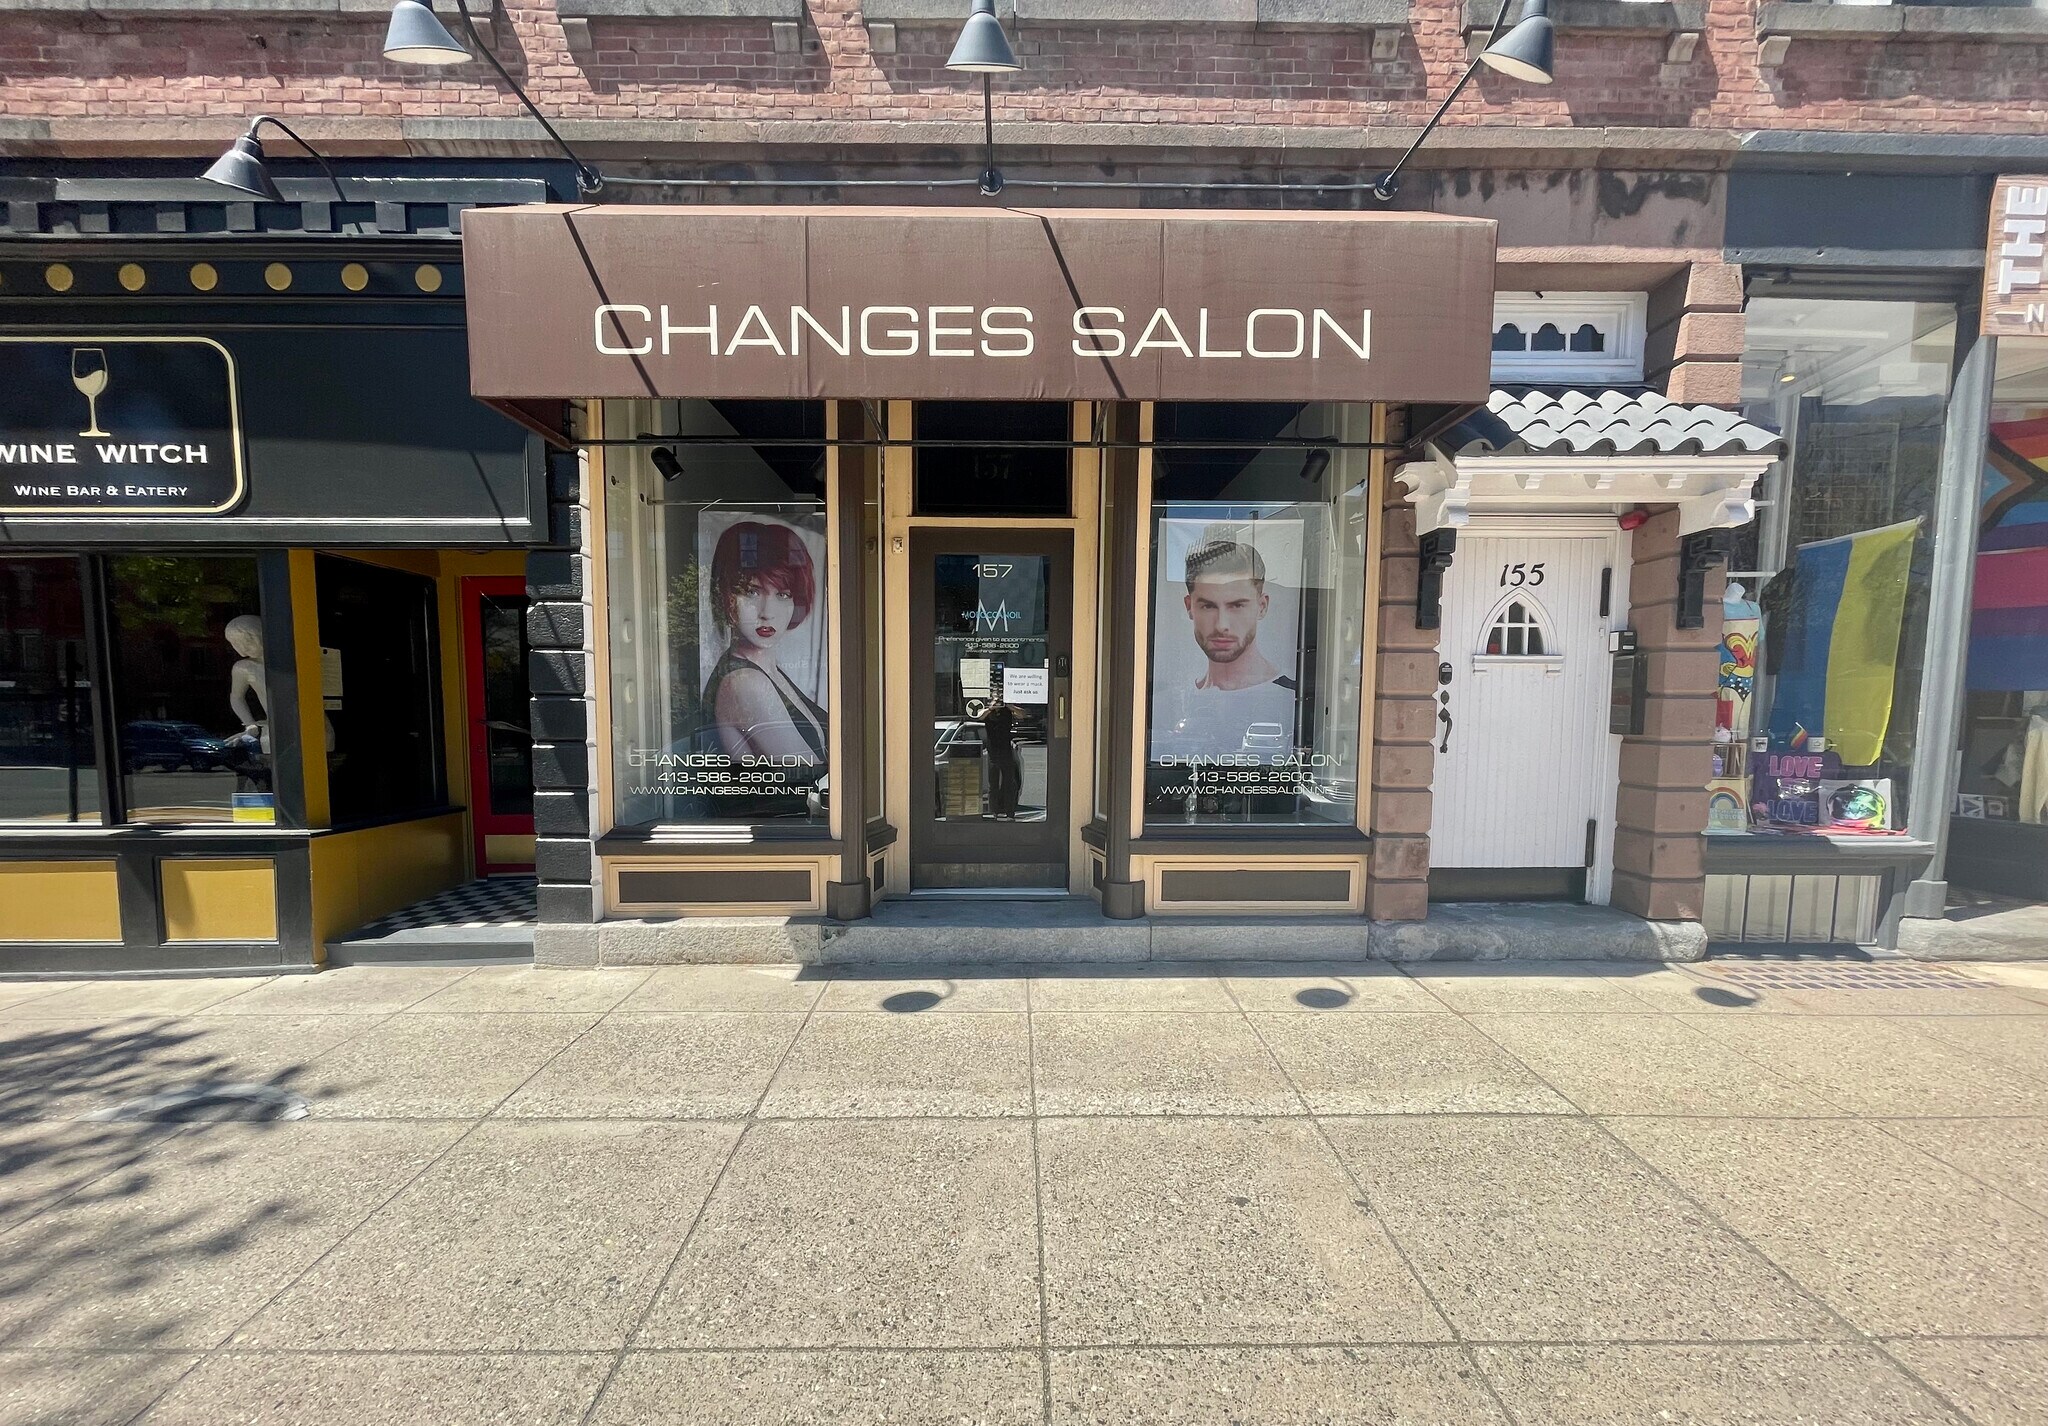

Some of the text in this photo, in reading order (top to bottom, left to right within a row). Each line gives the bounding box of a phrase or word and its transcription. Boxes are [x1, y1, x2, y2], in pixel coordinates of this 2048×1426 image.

[1997, 186, 2048, 294] THE
[594, 304, 1372, 360] CHANGES SALON
[95, 444, 208, 464] WITCH
[14, 485, 188, 497] WINE BAR & EATERY
[972, 563, 1013, 578] 157
[1500, 562, 1545, 587] 155
[629, 754, 814, 767] CHANGES SALON
[1159, 754, 1342, 767] CHANGES SALON
[1769, 755, 1823, 778] LOVE
[657, 772, 785, 783] 413-586-2600
[1187, 771, 1314, 782] 413-586-2600
[629, 786, 814, 795] WWW.CHANGESSALON.NET
[1767, 799, 1818, 822] LOVE
